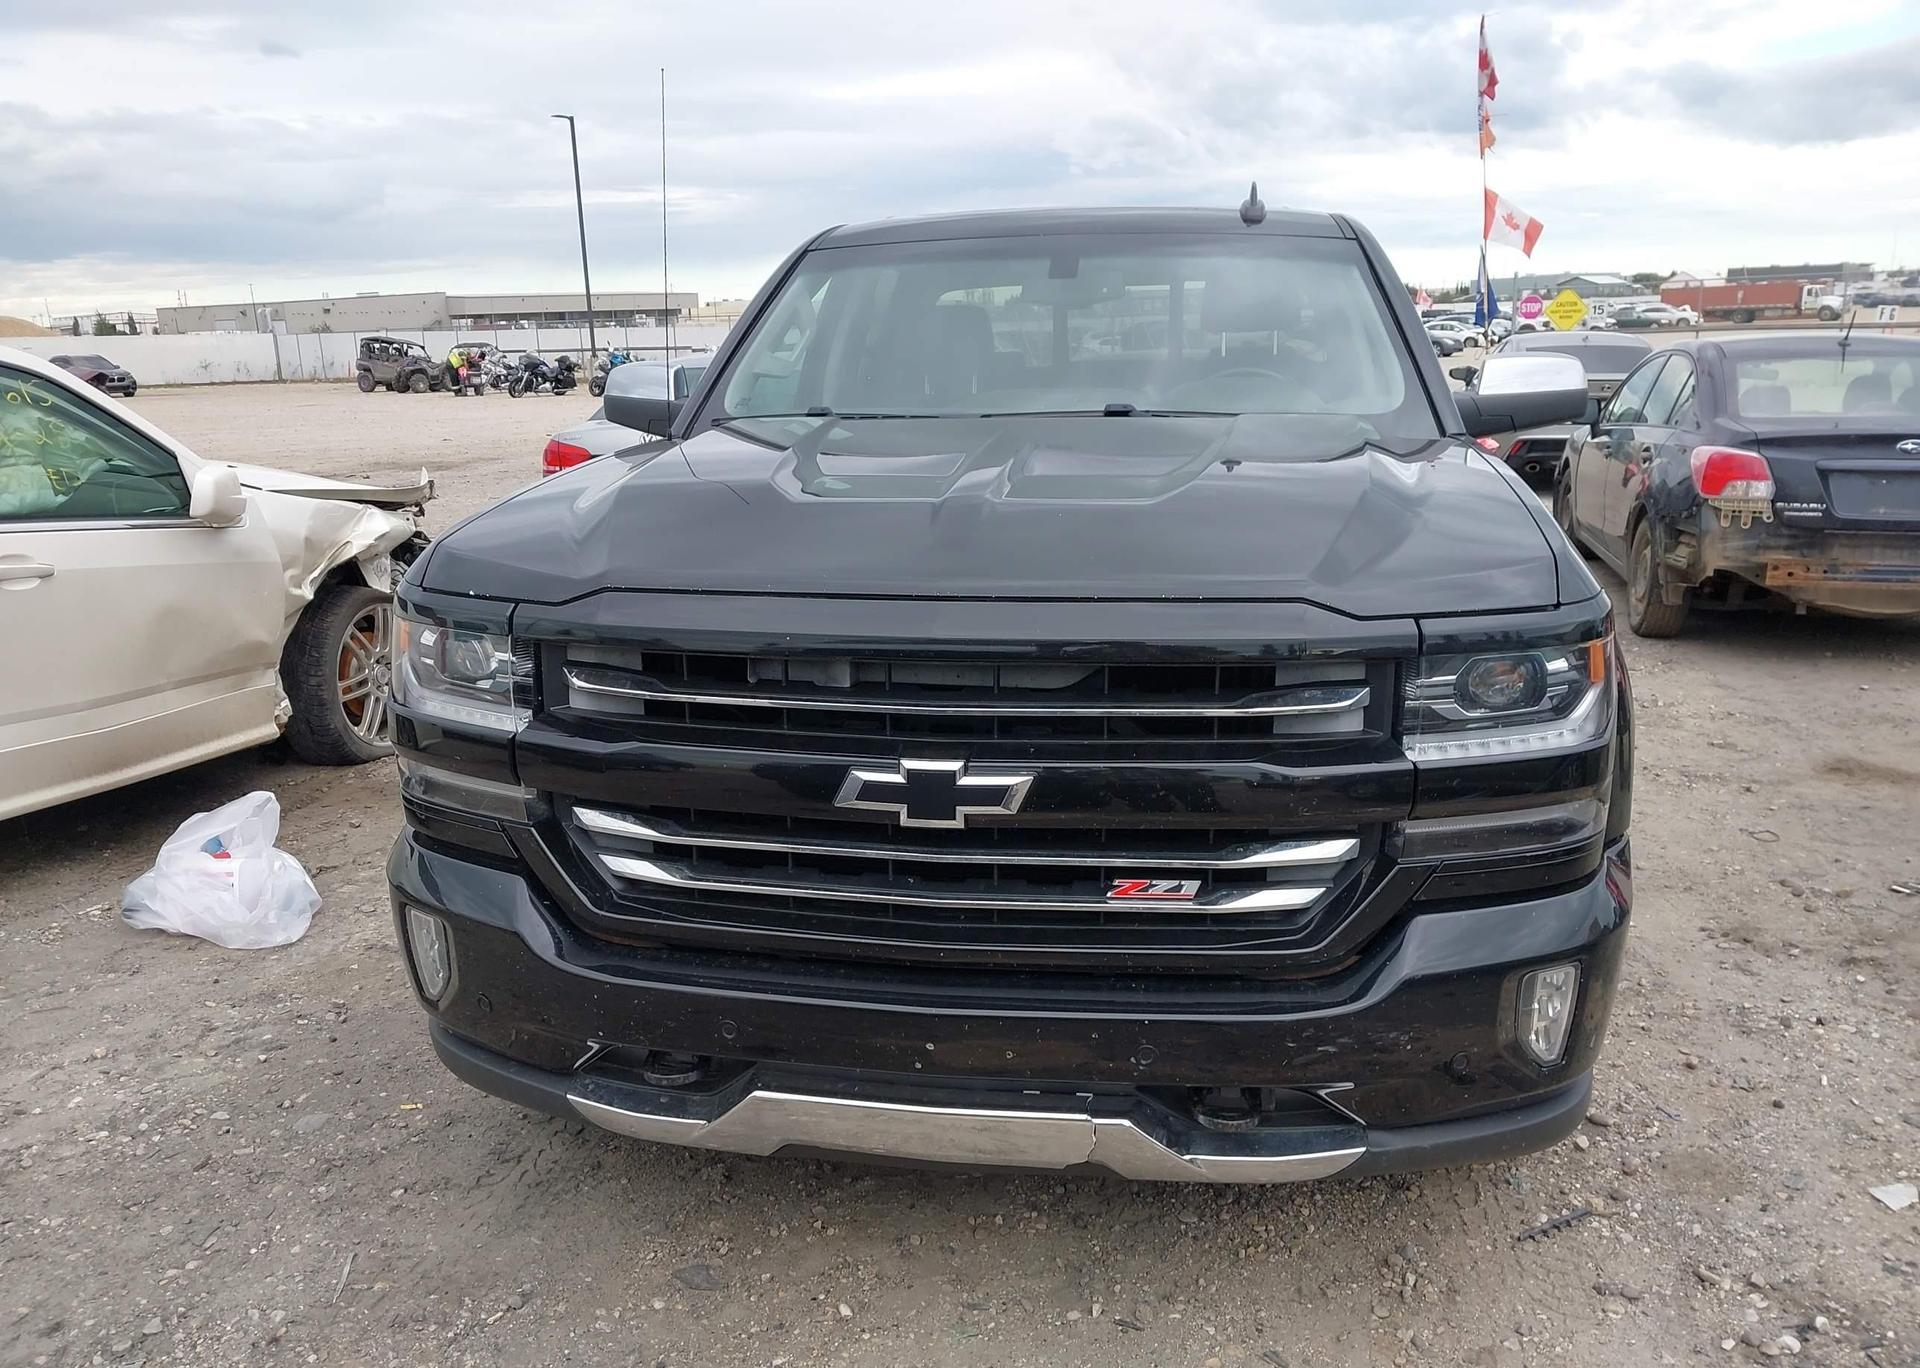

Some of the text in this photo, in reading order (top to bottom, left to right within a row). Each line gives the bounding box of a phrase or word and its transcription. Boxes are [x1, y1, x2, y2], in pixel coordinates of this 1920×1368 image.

[1521, 302, 1541, 313] STOP
[1592, 304, 1605, 315] 15
[1106, 879, 1202, 899] Z71
